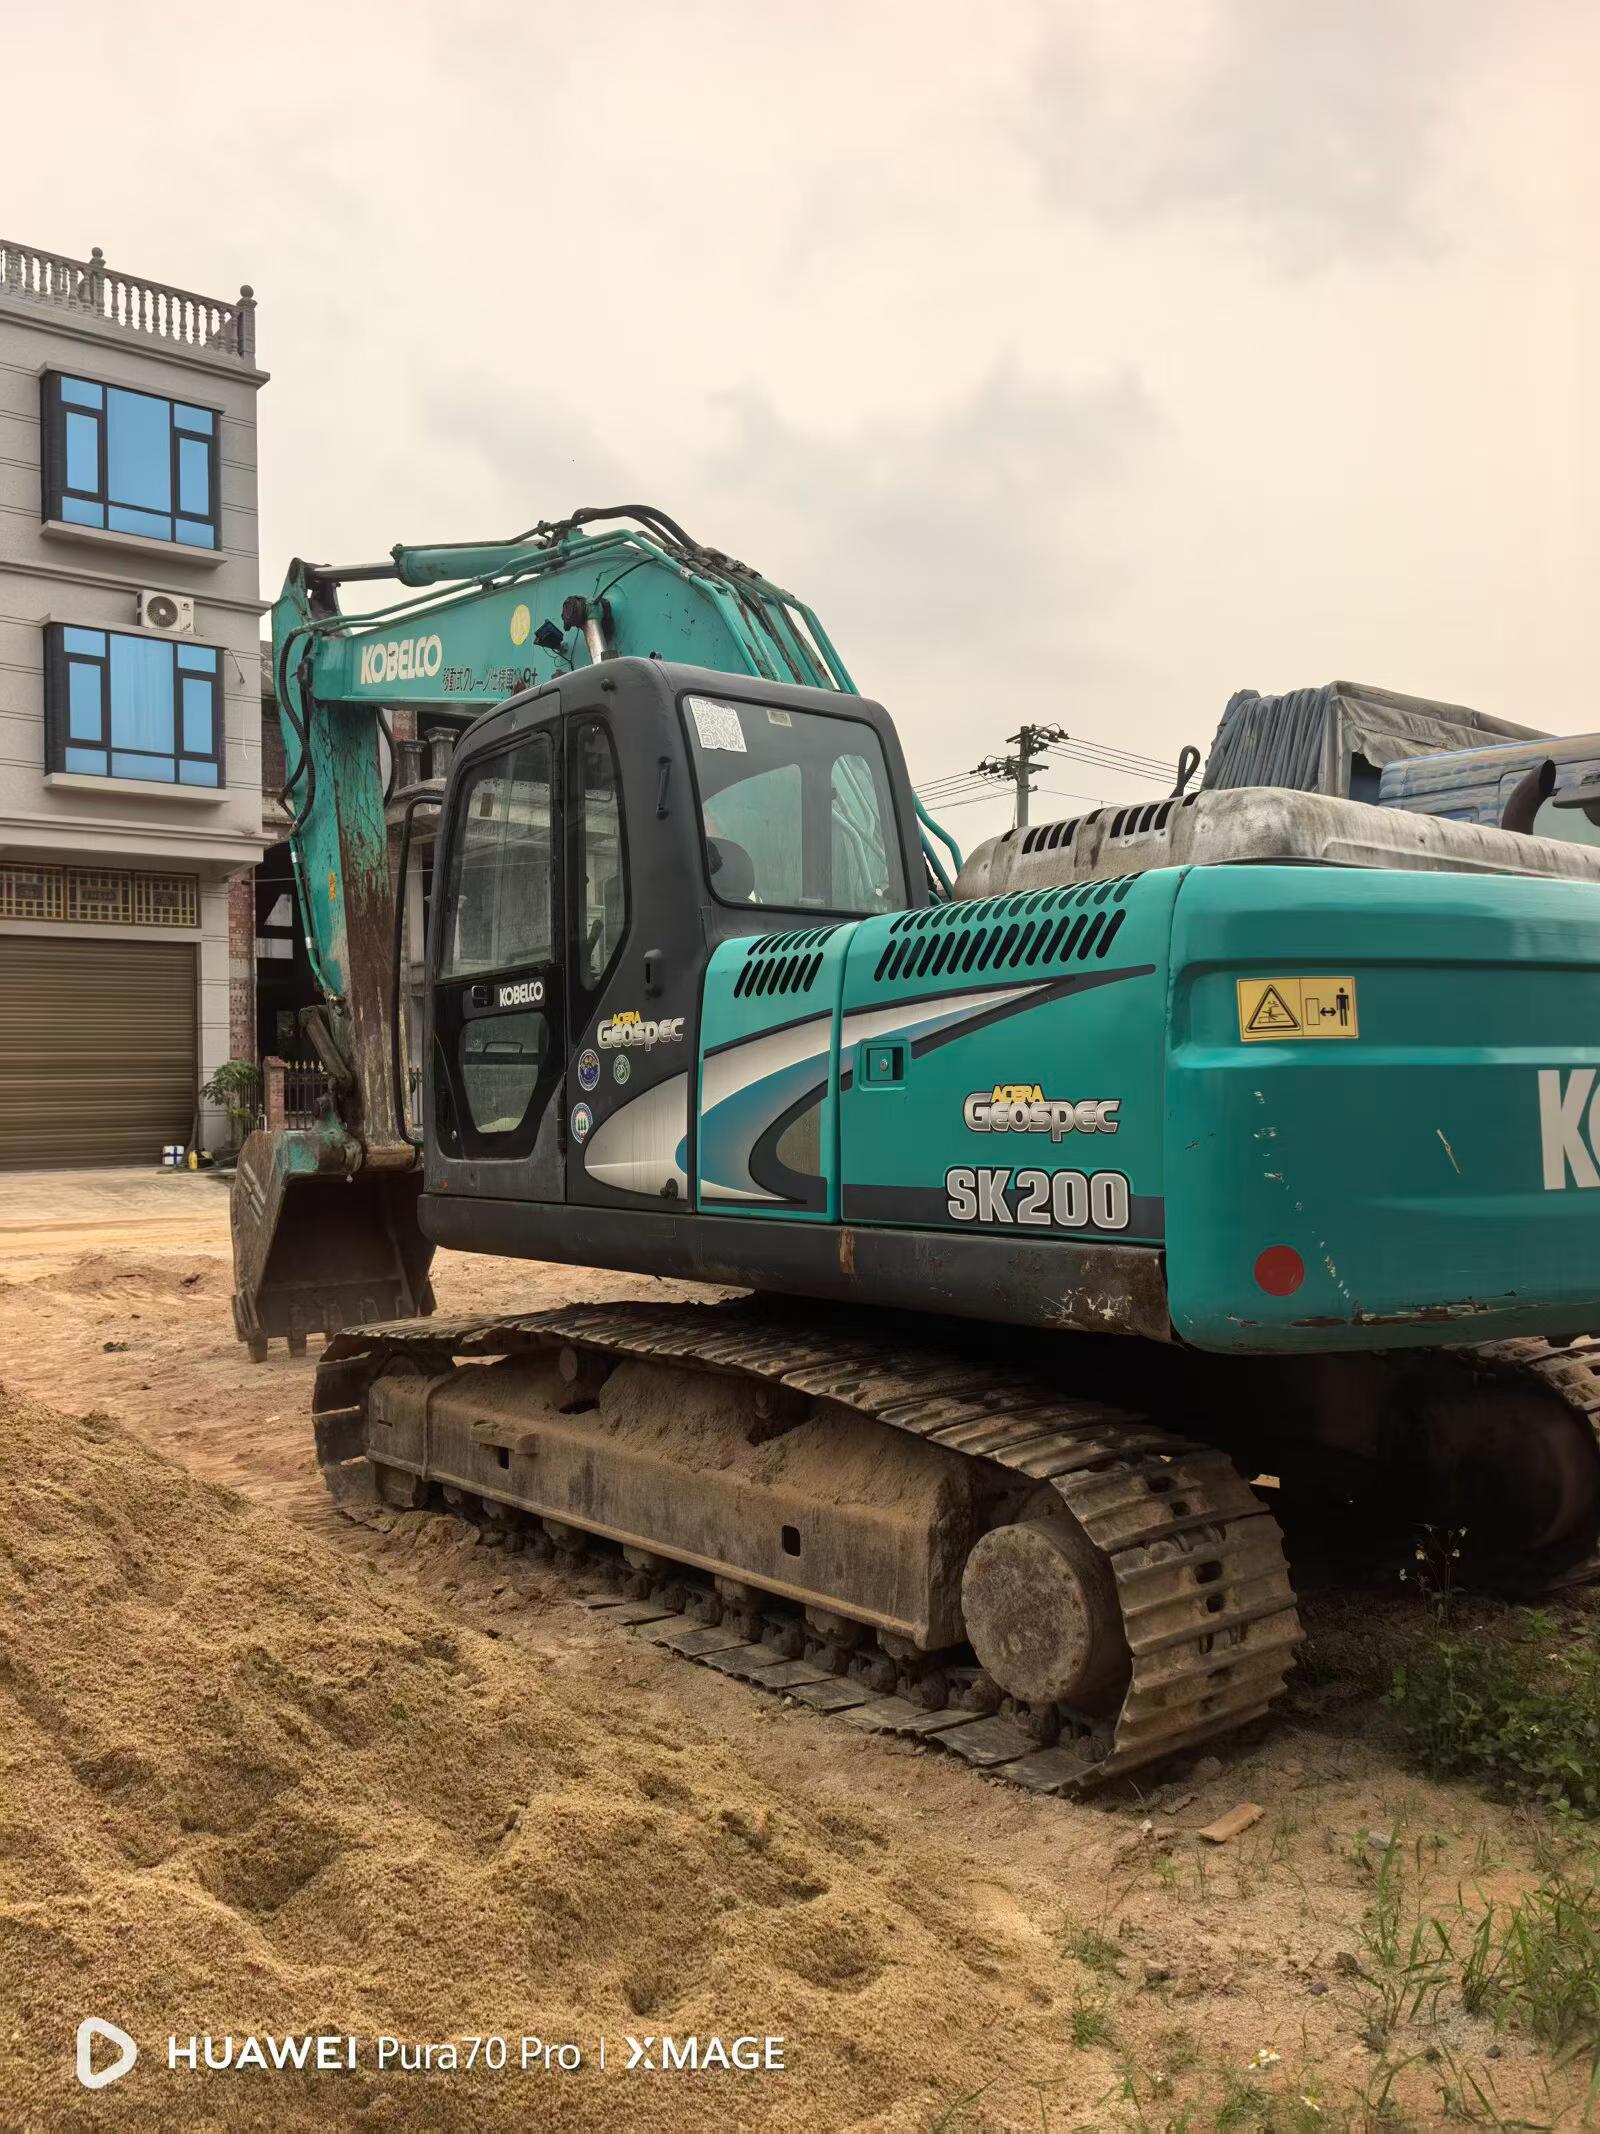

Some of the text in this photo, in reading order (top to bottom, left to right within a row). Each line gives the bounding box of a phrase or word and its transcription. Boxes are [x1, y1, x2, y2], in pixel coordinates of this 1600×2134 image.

[360, 634, 442, 684] KOBELCO
[499, 981, 544, 1008] KOBELCO
[612, 1011, 642, 1025] ACERA
[991, 1085, 1045, 1103] ACERA
[1537, 1068, 1600, 1191] K
[946, 1168, 1130, 1230] SK200
